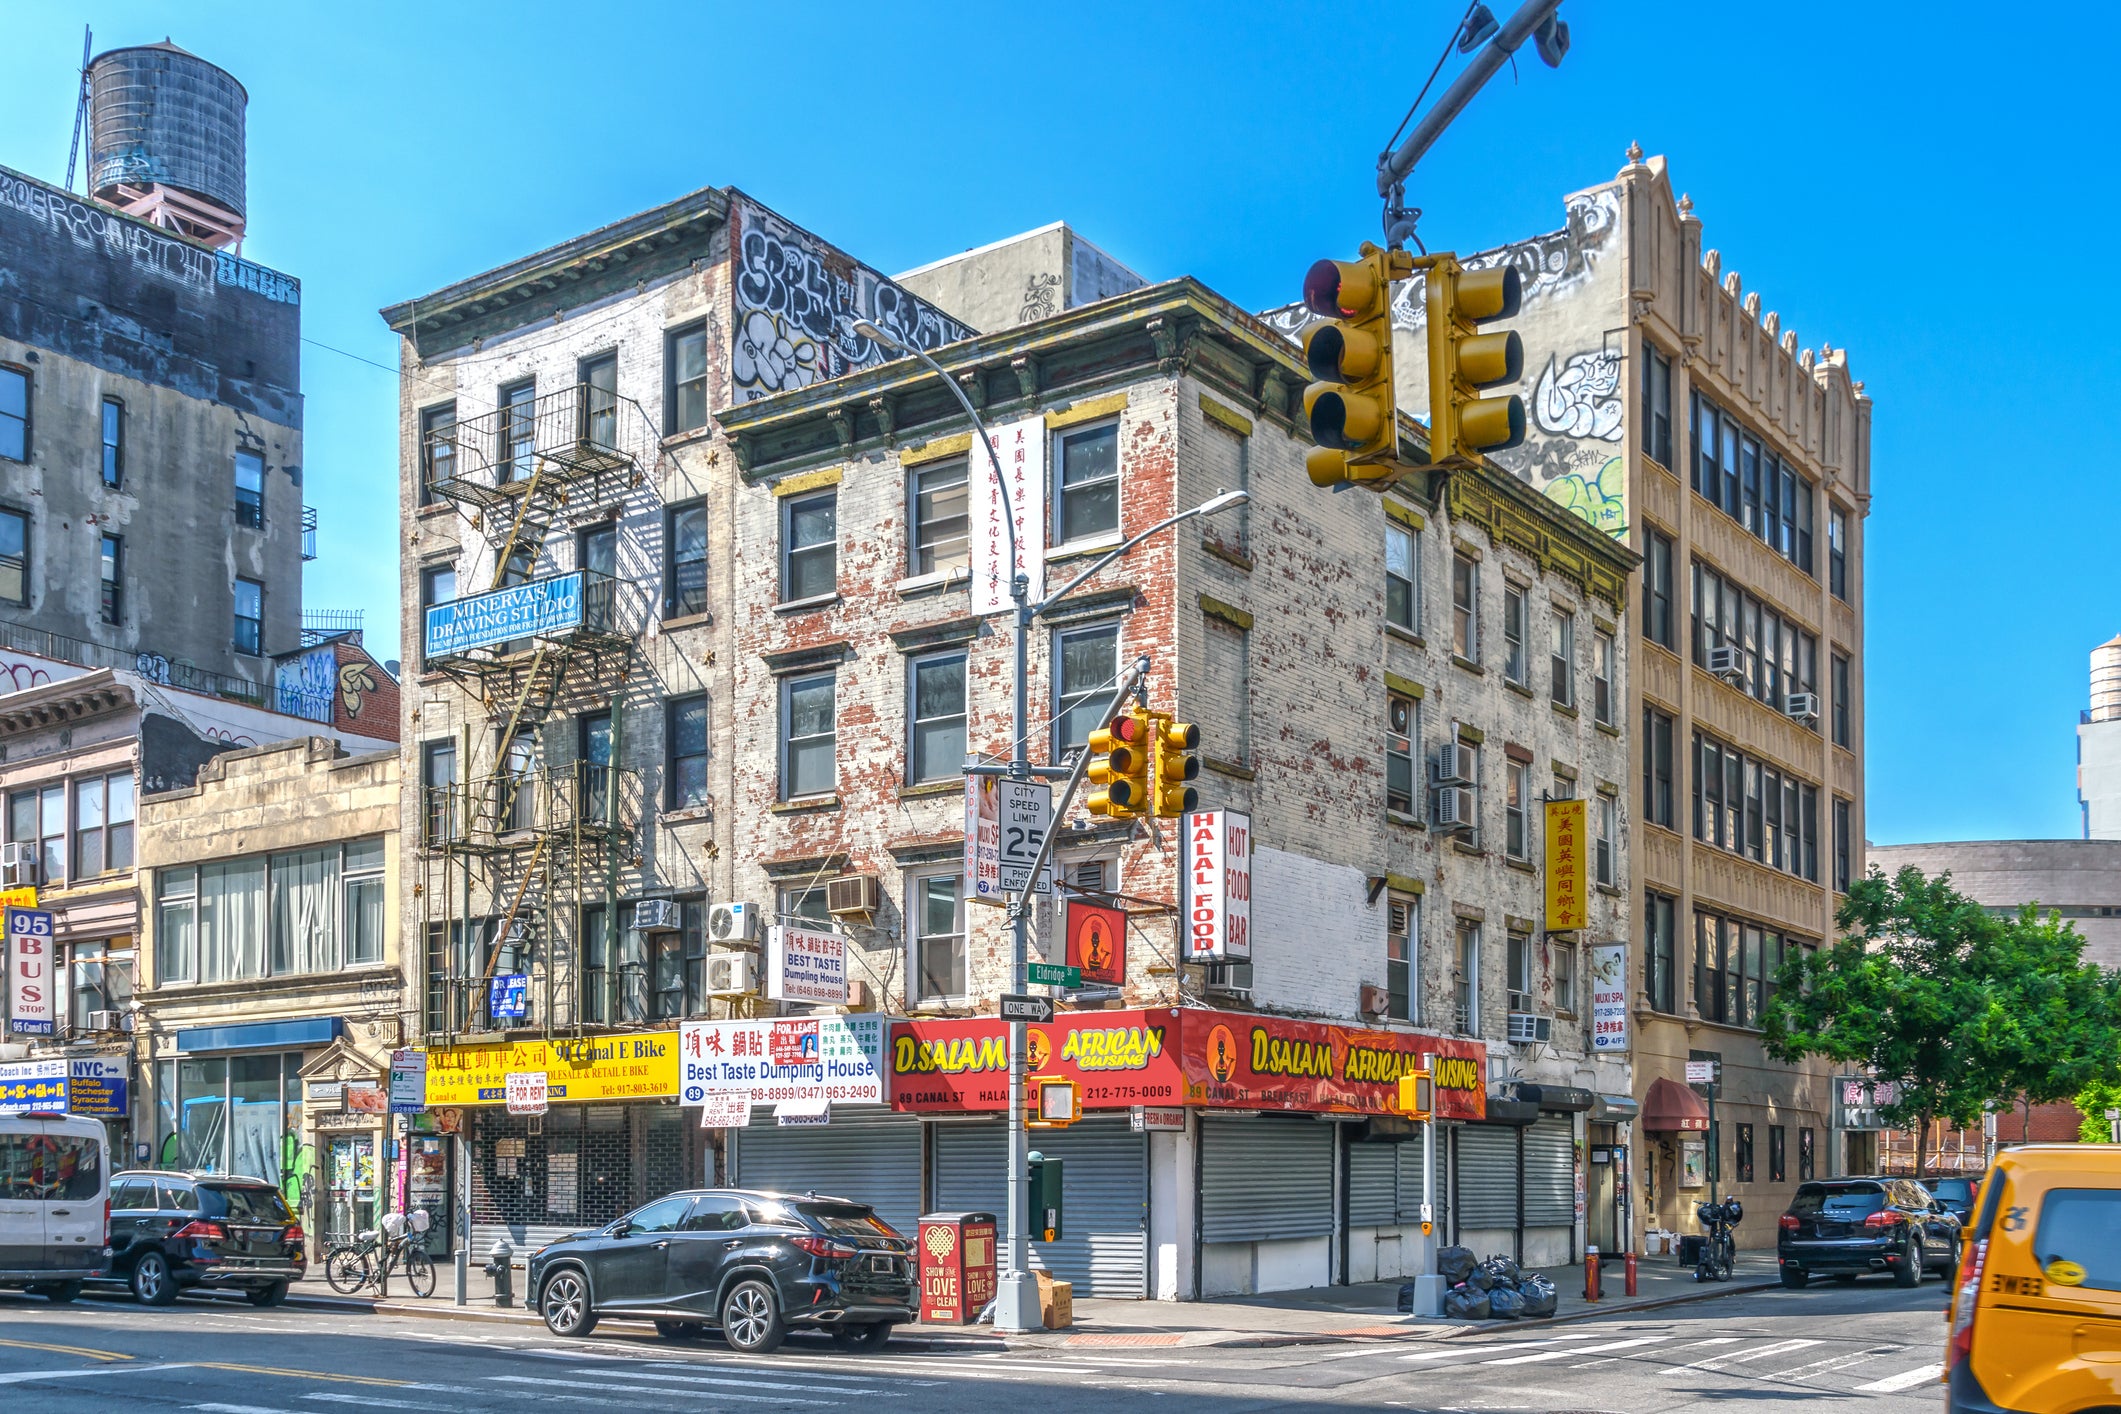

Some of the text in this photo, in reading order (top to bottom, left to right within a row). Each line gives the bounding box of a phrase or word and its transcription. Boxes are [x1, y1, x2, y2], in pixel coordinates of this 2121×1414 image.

[433, 595, 575, 640] DRAWING STUDIO
[469, 626, 508, 642] FOUNDATION
[509, 623, 522, 633] FOR
[1014, 787, 1036, 798] CITY
[1009, 799, 1040, 811] SPEED
[1012, 812, 1037, 824] LIMIT
[991, 824, 999, 846] SP
[1229, 826, 1246, 857] HOT
[1006, 827, 1044, 859] 25
[967, 834, 975, 878] WORK
[979, 882, 989, 892] 37
[1004, 879, 1047, 890] ENFOED
[1193, 813, 1214, 951] HALAL FOOD
[1226, 868, 1249, 901] FOOD
[14, 915, 49, 935] 95
[1229, 914, 1246, 946] BAR
[786, 932, 843, 956] 頂味 鍋貼餃子店
[20, 937, 42, 1002] BUS
[788, 953, 840, 971] BEST TASTE
[784, 968, 843, 984] Dumpling House
[1036, 966, 1072, 984] Eldridge St
[785, 984, 843, 999] Tel: (646) 698-8899
[1595, 992, 1624, 1004] MUXI SPA
[18, 1005, 45, 1013] STOP
[1008, 1002, 1046, 1015] ONE WAY
[13, 1022, 52, 1033] 95 Canal ST
[776, 1021, 817, 1034] FOR LEASE
[576, 1042, 614, 1061] Canal
[619, 1041, 628, 1058] E
[634, 1040, 666, 1058] Bike
[685, 1028, 725, 1058] 頂味
[1061, 1028, 1163, 1058] AFRICAN
[893, 1035, 1008, 1073] D.SALAM
[1251, 1028, 1333, 1078] D.SALAM
[1079, 1054, 1145, 1068] CUISINE
[1345, 1047, 1478, 1090] AFRICAN UISINE
[0, 1066, 32, 1077] Coach Inc
[73, 1061, 104, 1077] NYC
[547, 1068, 582, 1080] OLESALE
[584, 1068, 590, 1079] &
[592, 1066, 620, 1078] RETAIL
[622, 1066, 628, 1076] E
[629, 1065, 649, 1076] BIKE
[688, 1059, 874, 1083] Best Taste Dumpling House
[36, 1084, 47, 1097] GA
[56, 1083, 65, 1097] FL
[71, 1079, 101, 1087] Buffalo
[601, 1082, 668, 1095] Tel: 917-803-3619
[430, 1093, 450, 1102] Canal
[516, 1086, 545, 1101] FOR RENT
[547, 1086, 564, 1096] KING
[688, 1088, 700, 1100] 89
[751, 1086, 824, 1100] 98-8899/(347)
[826, 1085, 877, 1099] 963-2490
[900, 1092, 912, 1103] 89
[915, 1092, 949, 1103] CANAL
[952, 1091, 965, 1102] ST
[1087, 1085, 1172, 1099] 212-775-0009
[1190, 1086, 1201, 1097] 89
[1206, 1087, 1235, 1100] CANAL
[1239, 1089, 1250, 1100] ST
[0, 1102, 30, 1111] Coach.com
[727, 1102, 745, 1113] 出租
[1145, 1112, 1159, 1125] FRESH
[1163, 1113, 1184, 1126] ORGANIC
[1845, 1108, 1888, 1126] KT
[926, 1267, 944, 1277] SHOW
[926, 1278, 957, 1296] LOVE
[967, 1279, 986, 1294] LOVE
[937, 1297, 958, 1307] CLEAN
